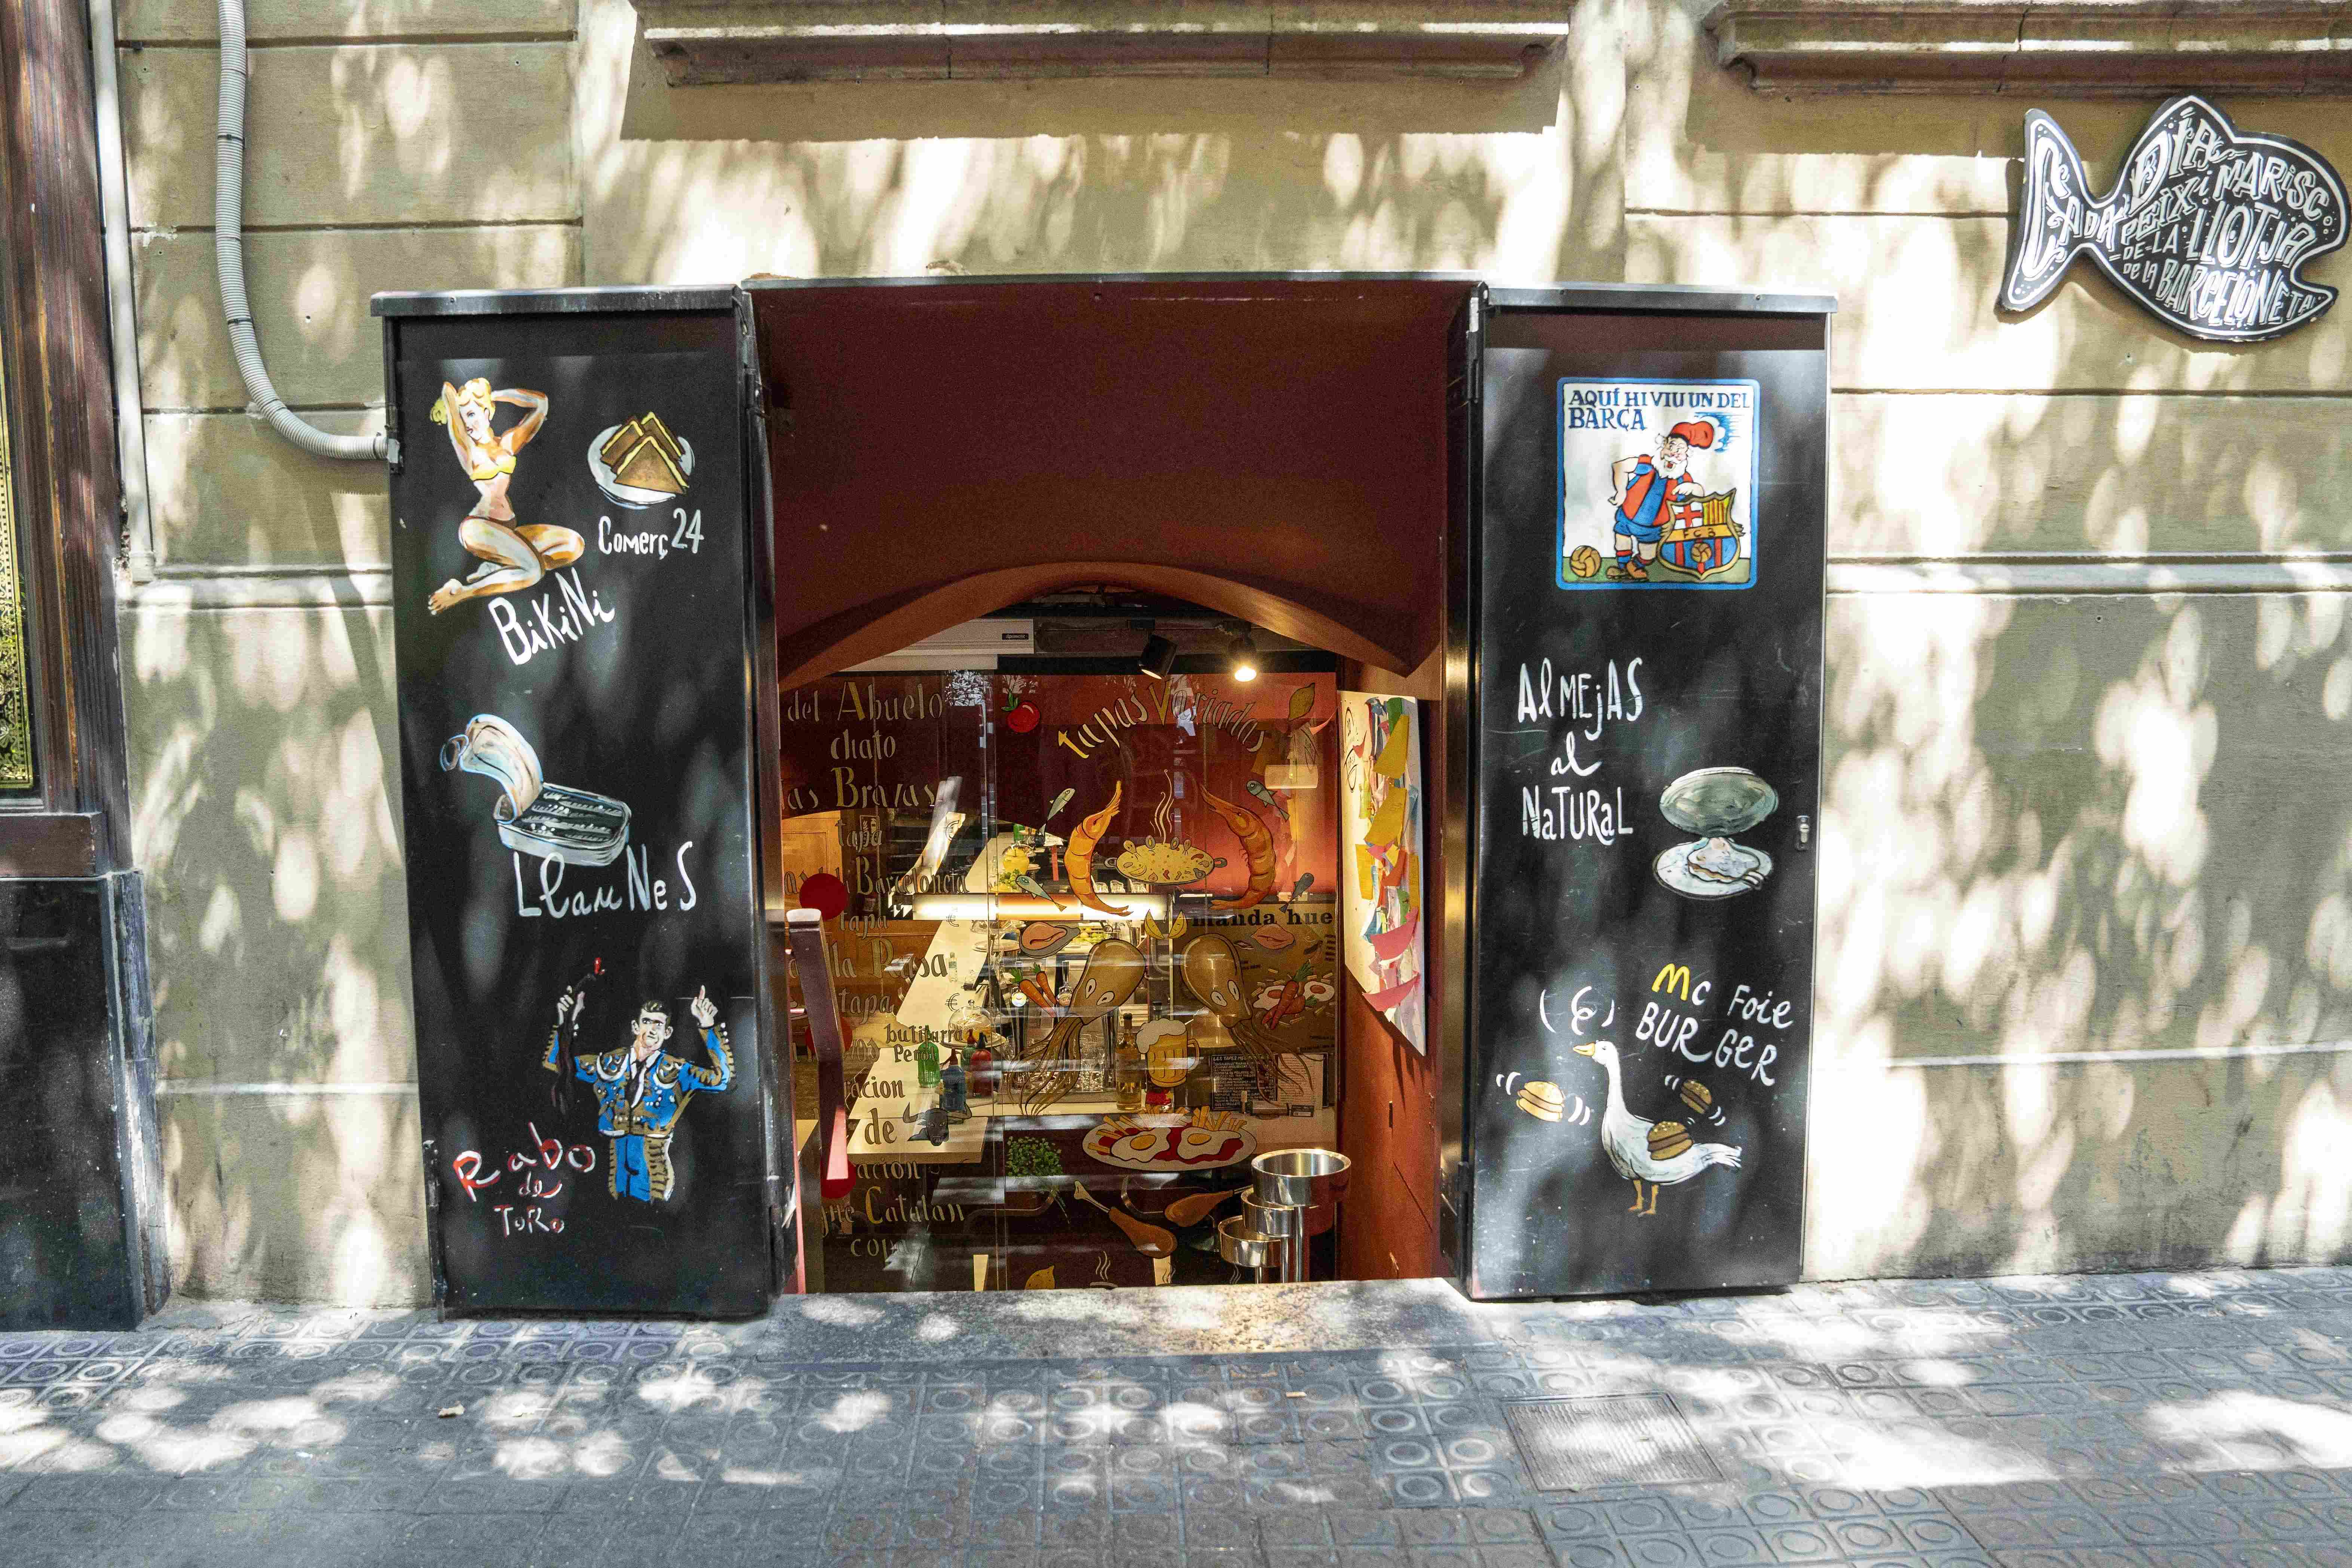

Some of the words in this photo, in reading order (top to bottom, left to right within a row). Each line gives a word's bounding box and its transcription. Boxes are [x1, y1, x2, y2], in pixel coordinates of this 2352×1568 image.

[2021, 137, 2129, 281] CADA
[1568, 388, 1621, 407] AQUÍ
[1624, 391, 1648, 407] HI
[1650, 391, 1686, 408] VIU
[1688, 392, 1713, 408] UN
[1716, 392, 1750, 408] DEL
[1568, 407, 1647, 431] BARÇA
[671, 508, 704, 554] 24
[787, 690, 820, 722] del
[837, 681, 943, 722] Abuelo
[830, 729, 897, 760] chato
[1550, 731, 1602, 777] al
[834, 818, 883, 853] tapa
[839, 911, 889, 939] tapa
[838, 987, 894, 1024] tapa
[1651, 963, 1712, 1006] Mc
[1727, 984, 1795, 1029] Foie
[864, 1107, 898, 1145] de
[518, 1171, 563, 1198] de
[856, 1157, 921, 1179] acion
[865, 1186, 965, 1224] Catalan
